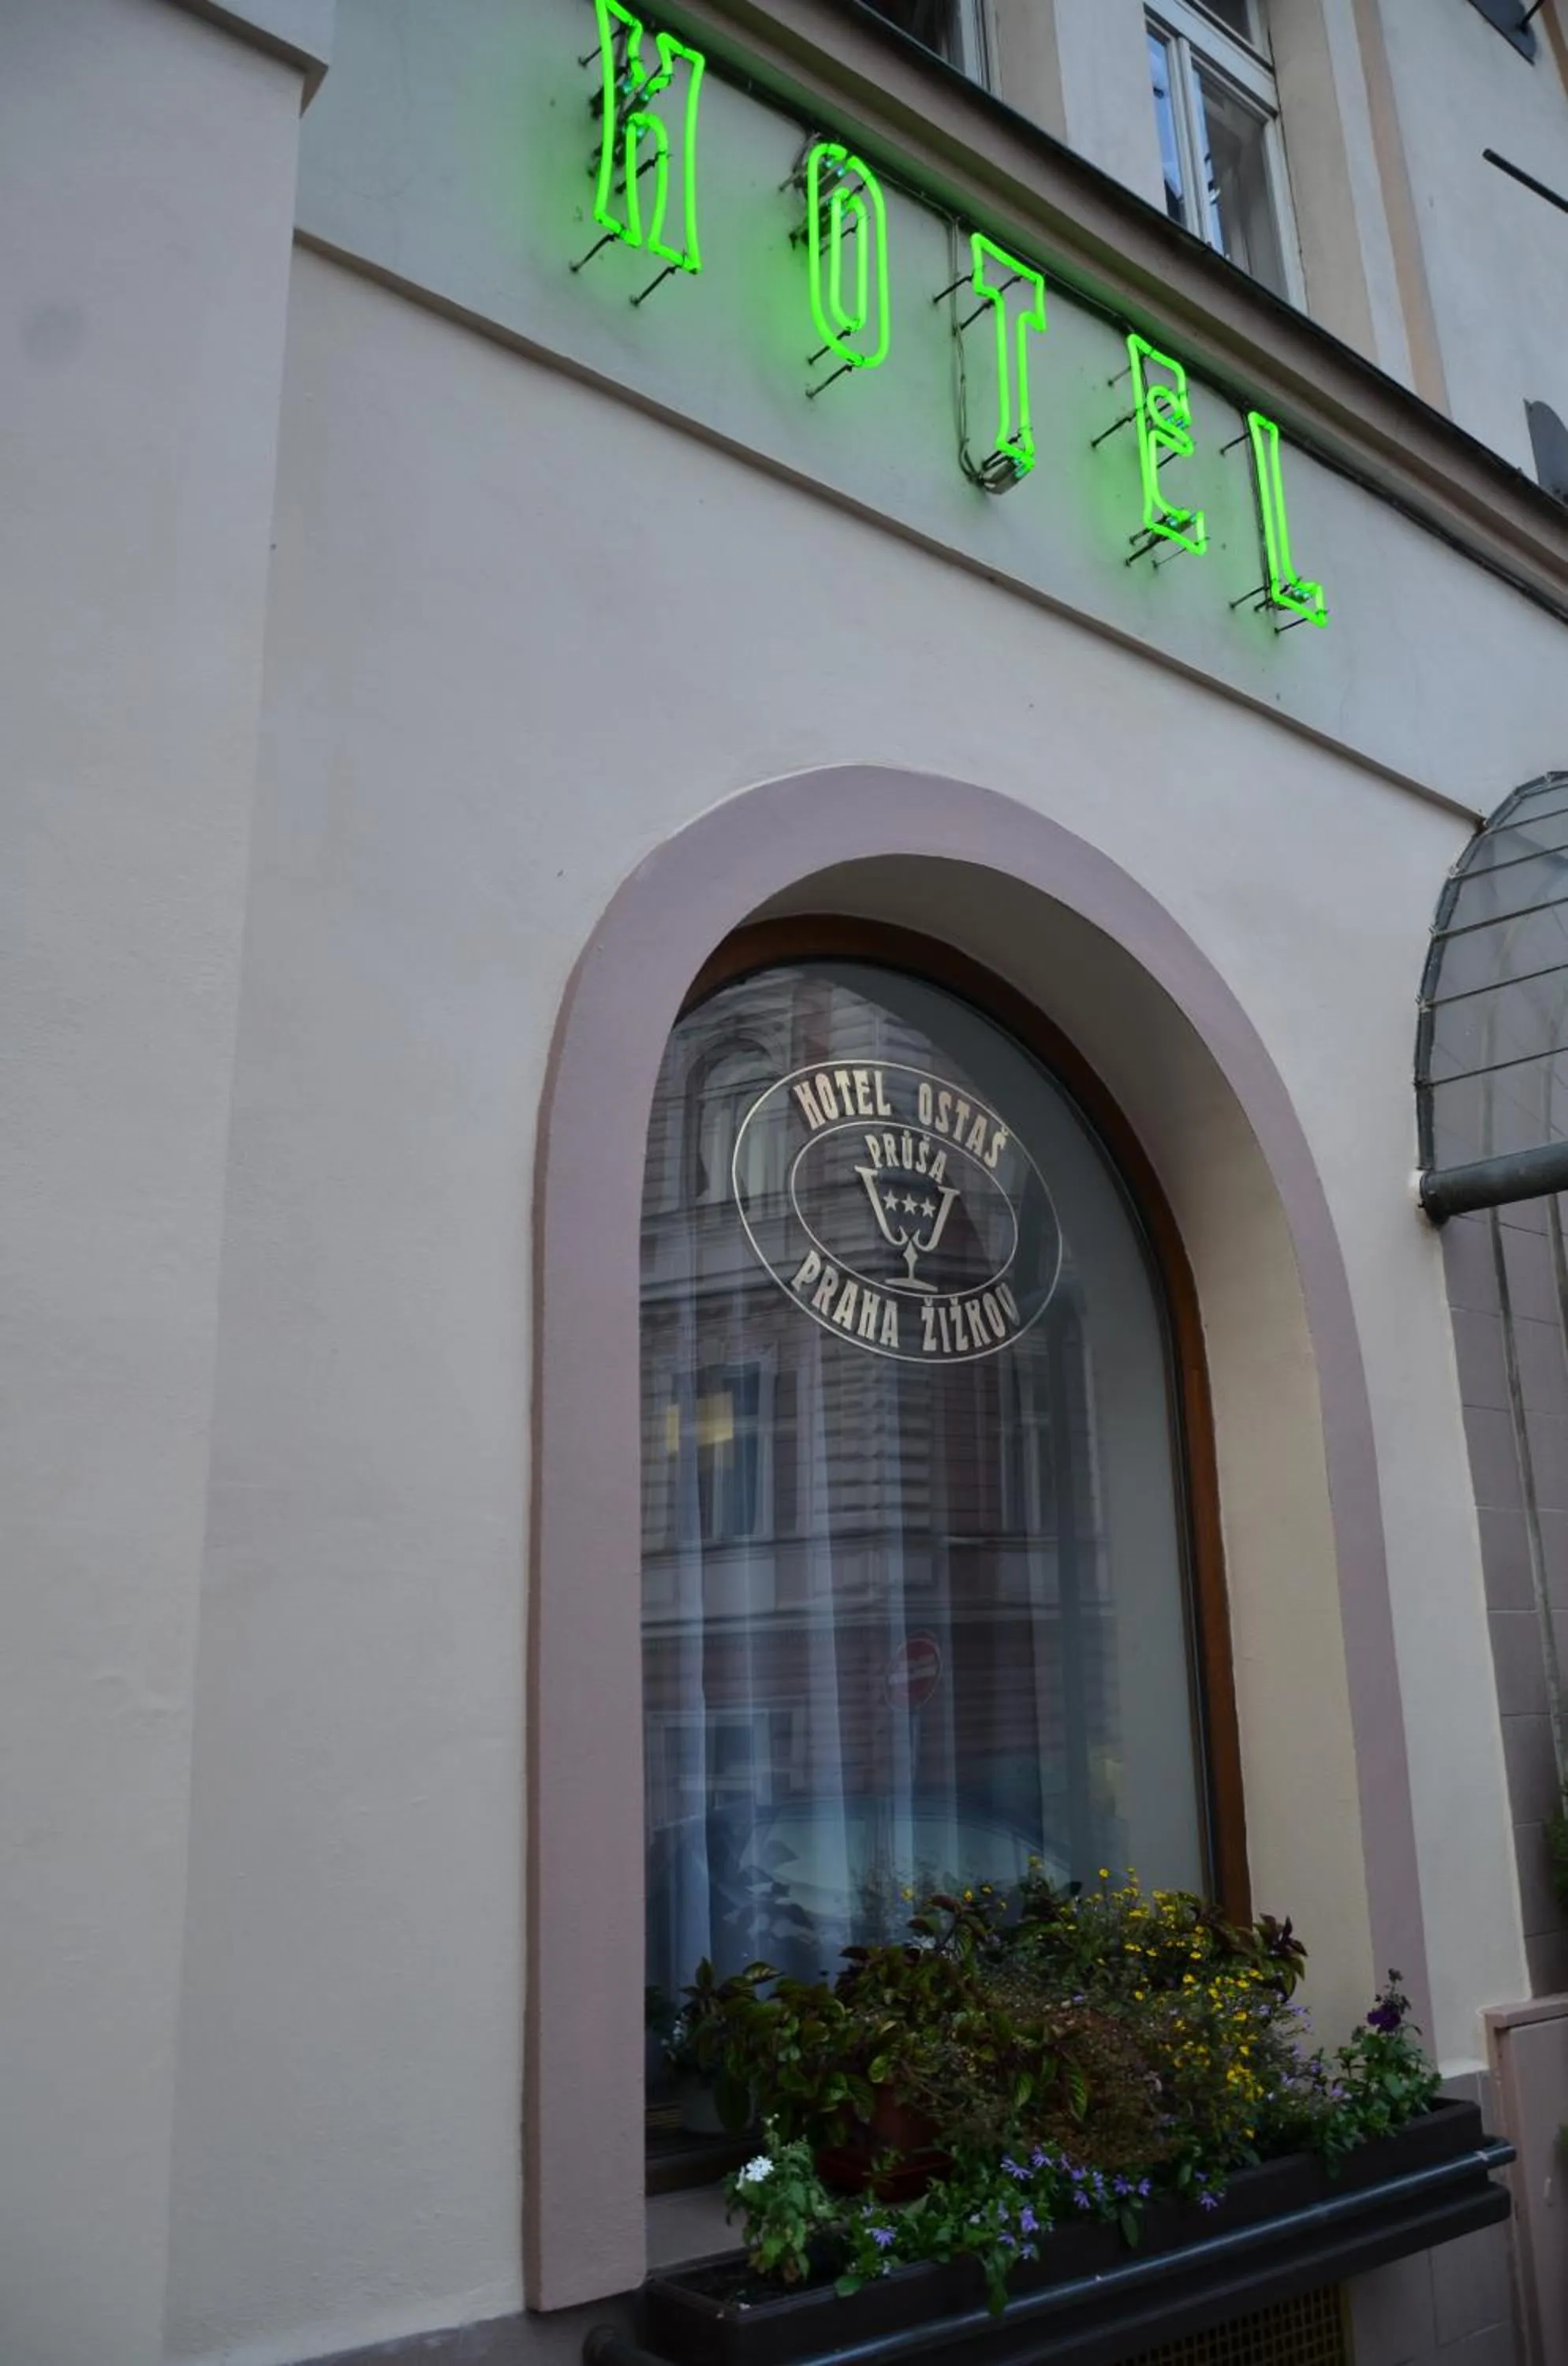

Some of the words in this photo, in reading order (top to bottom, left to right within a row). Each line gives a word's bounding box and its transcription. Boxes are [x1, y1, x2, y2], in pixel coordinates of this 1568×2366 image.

[593, 0, 1327, 626] HOTEL
[793, 1069, 891, 1131] HOTEL
[791, 1250, 899, 1348] PRAHA
